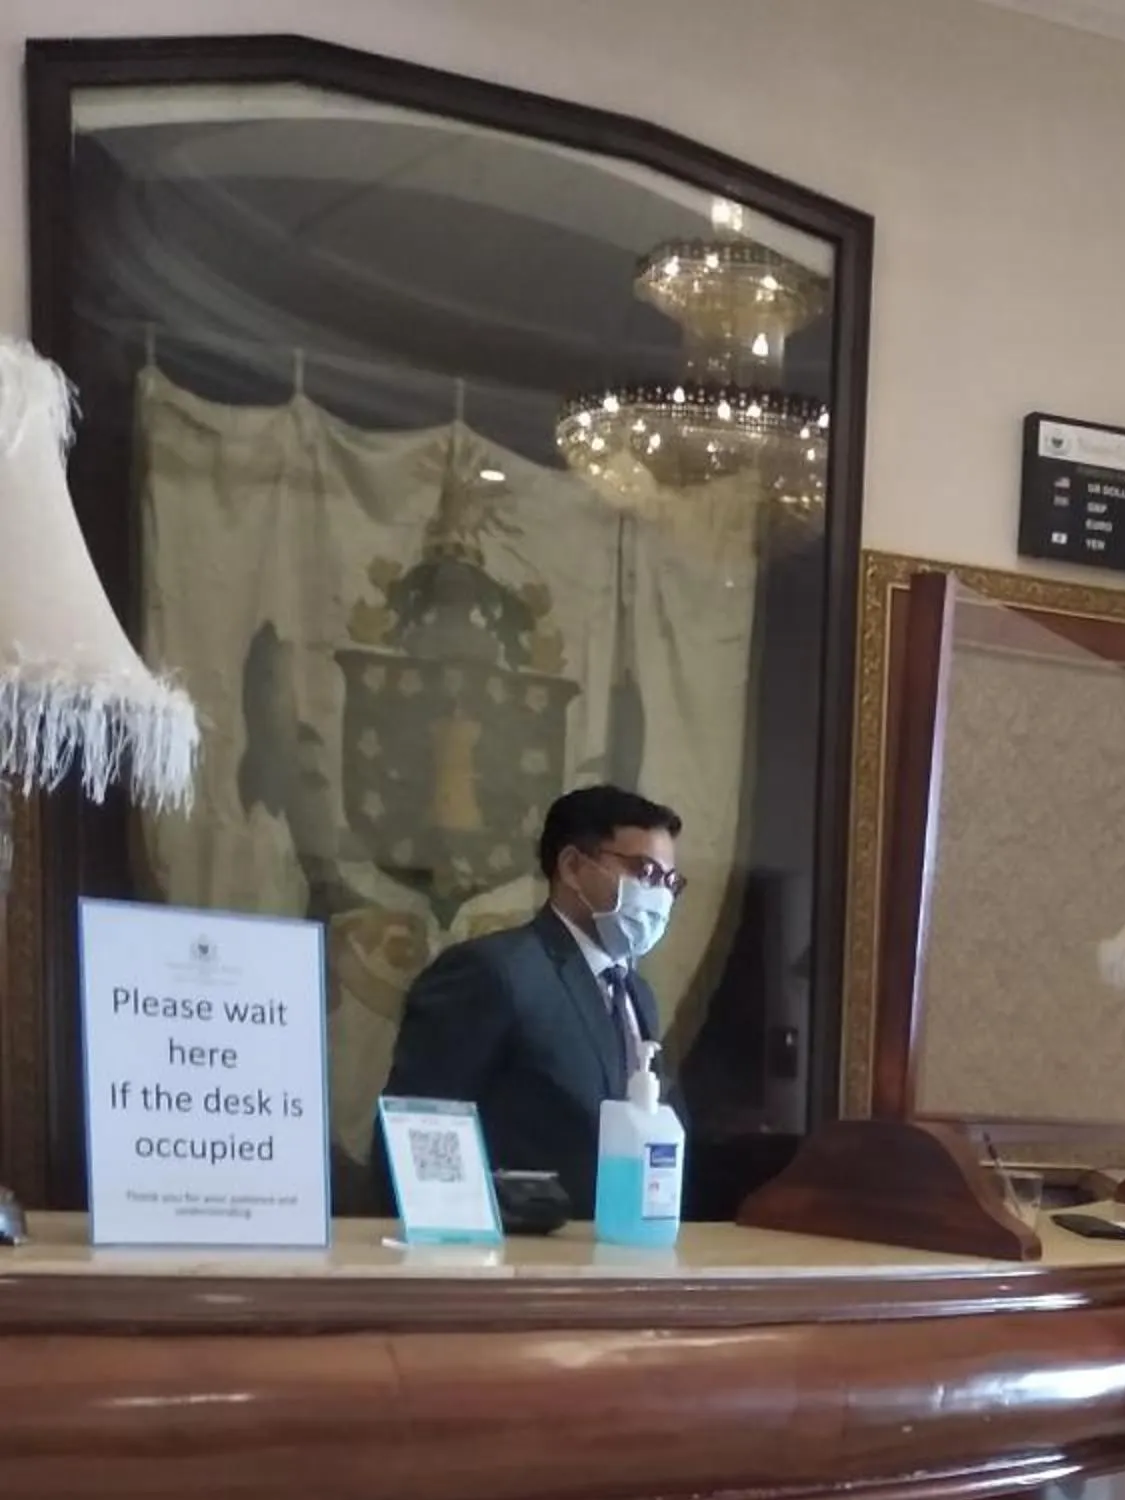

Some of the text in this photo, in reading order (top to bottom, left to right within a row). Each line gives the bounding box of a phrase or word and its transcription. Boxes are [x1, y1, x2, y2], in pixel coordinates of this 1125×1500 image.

[1085, 518, 1113, 532] EURO
[1086, 538, 1106, 551] YEN
[112, 986, 289, 1027] Please wait
[168, 1038, 239, 1069] here
[110, 1081, 305, 1118] If the desk is
[134, 1134, 275, 1166] occupied
